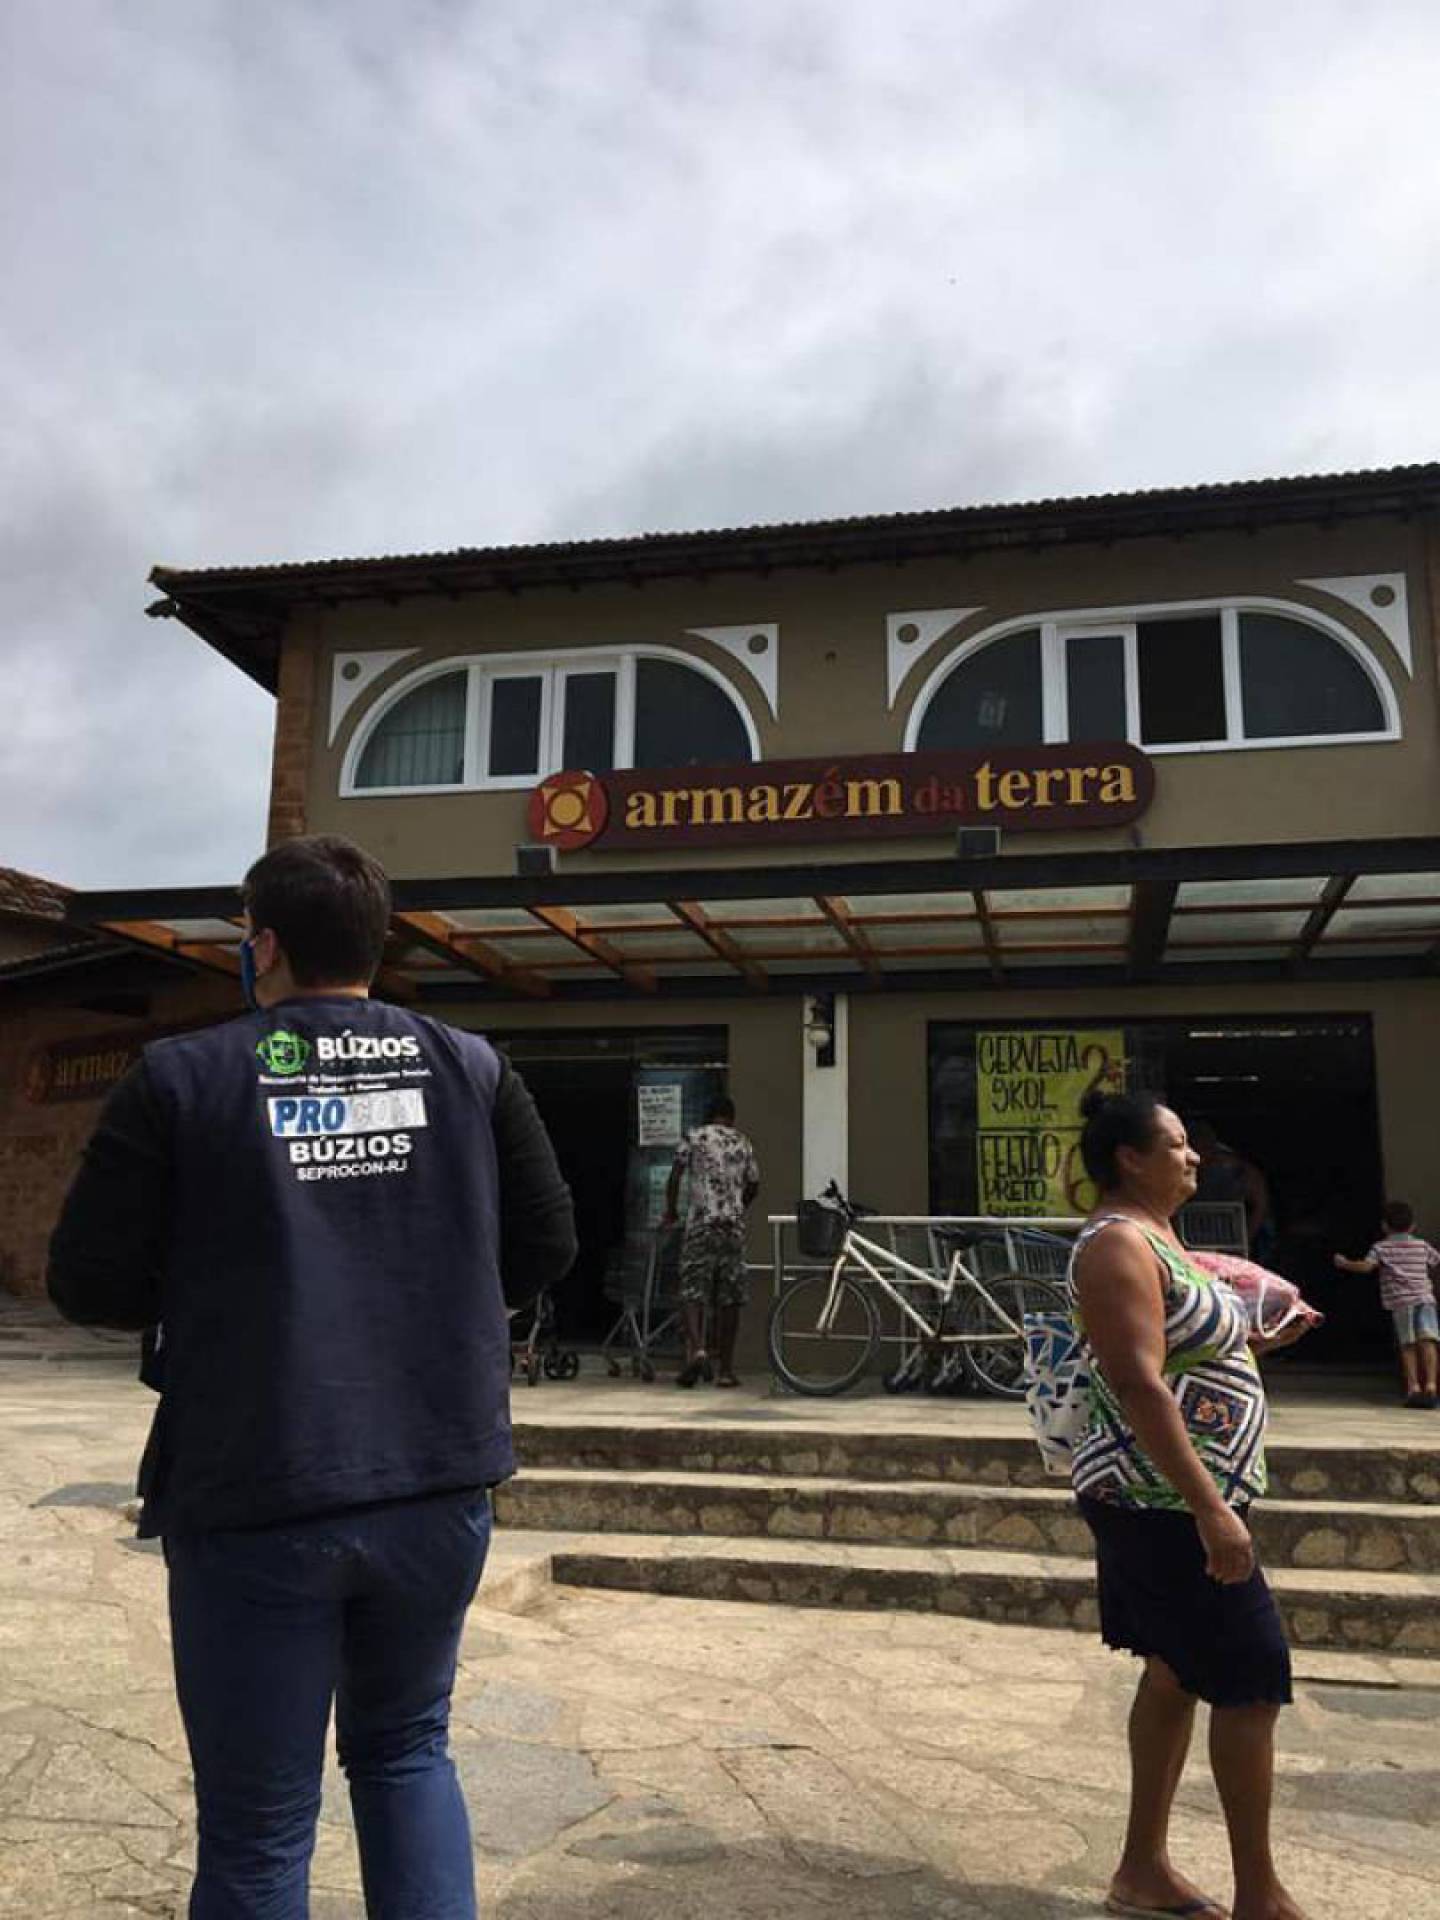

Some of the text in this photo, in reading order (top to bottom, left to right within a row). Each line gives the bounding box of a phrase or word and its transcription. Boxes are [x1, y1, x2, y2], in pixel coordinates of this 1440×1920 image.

[625, 760, 1136, 829] armazém da terra
[317, 1029, 420, 1060] BÚZIOS
[979, 1035, 1078, 1074] CERVEJA
[992, 1077, 1059, 1113] SKOL
[289, 1134, 412, 1164] BÚZIOS
[297, 1159, 408, 1181] SEPROCON-RJ
[984, 1178, 1047, 1202] PRETO
